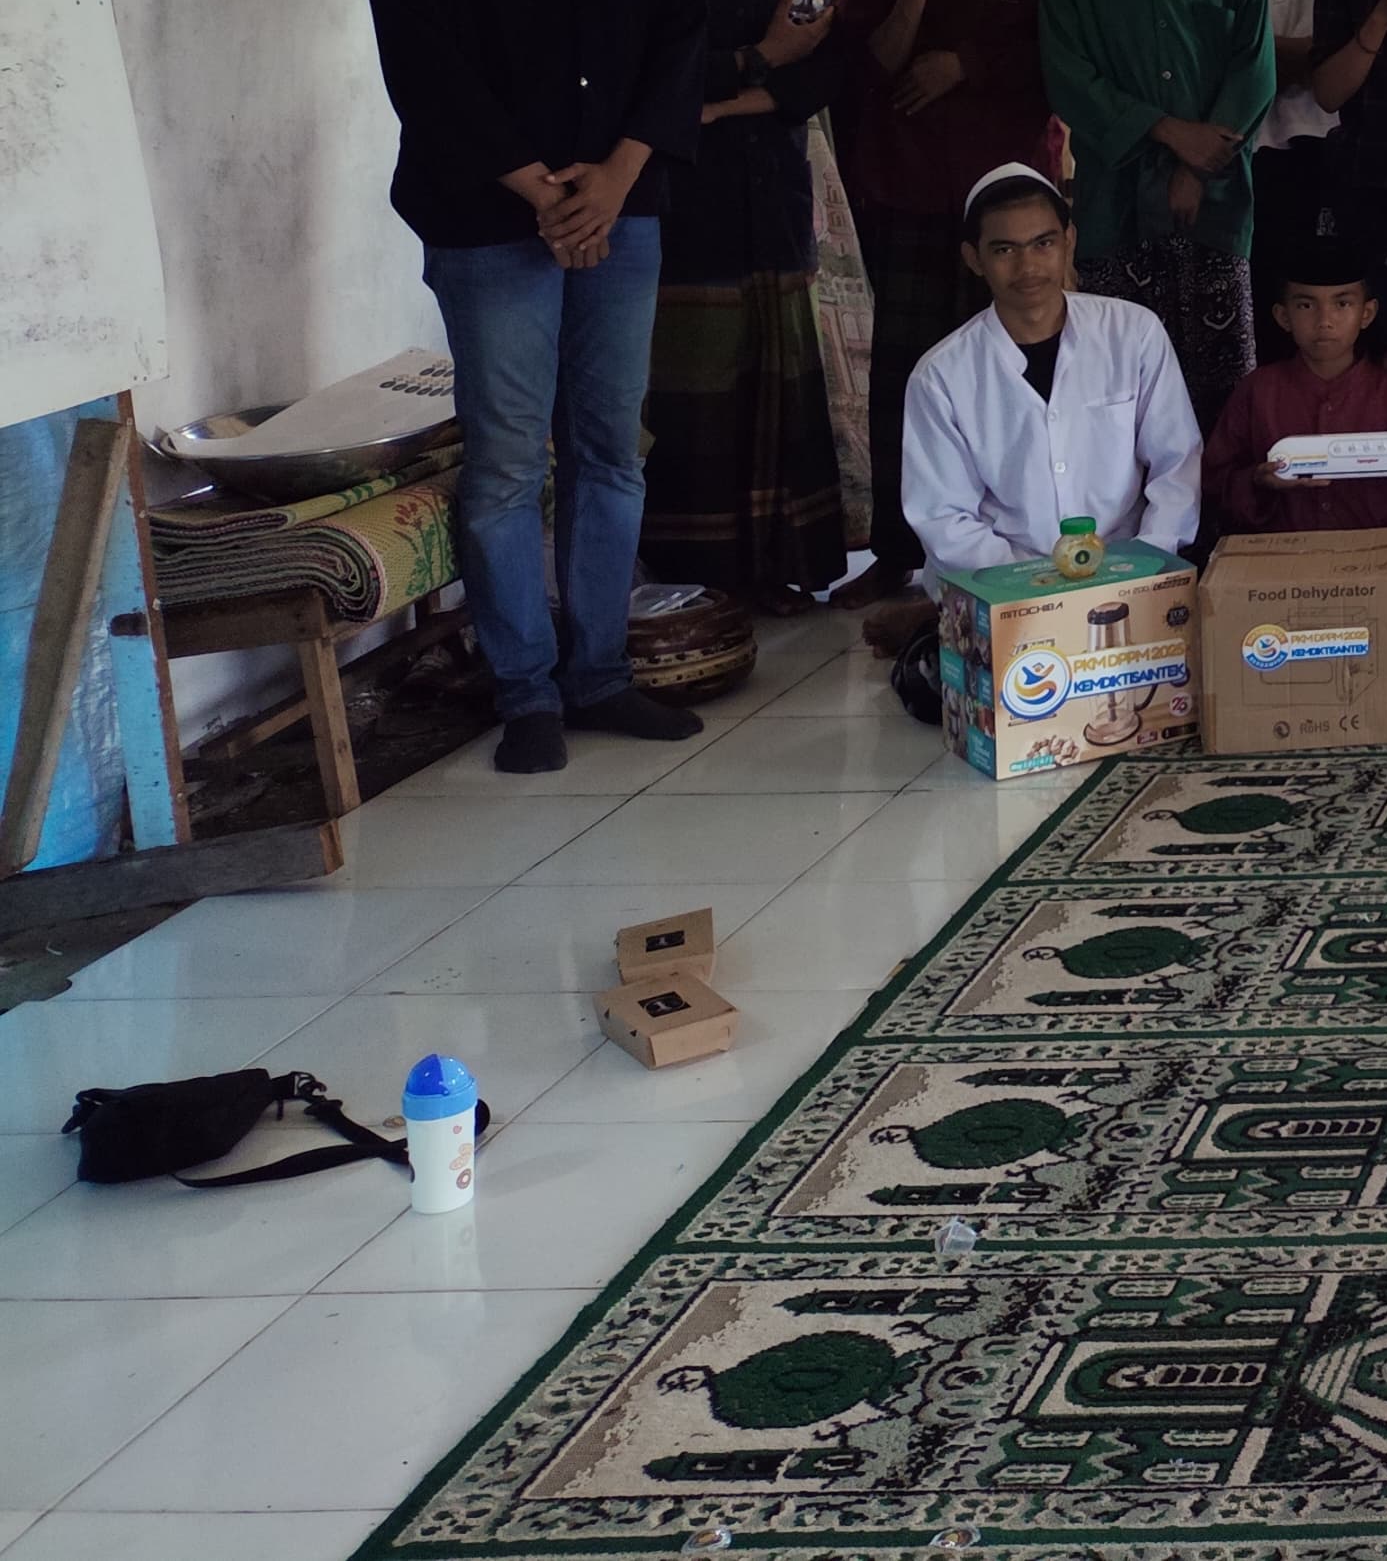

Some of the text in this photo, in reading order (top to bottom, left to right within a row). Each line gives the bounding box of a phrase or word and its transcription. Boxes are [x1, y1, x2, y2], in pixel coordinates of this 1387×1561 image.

[1248, 585, 1376, 602] Food Dehydrator
[1291, 634, 1313, 644] PKM
[1074, 644, 1186, 674] PKM DPPM 2025
[1338, 714, 1360, 732] CE
